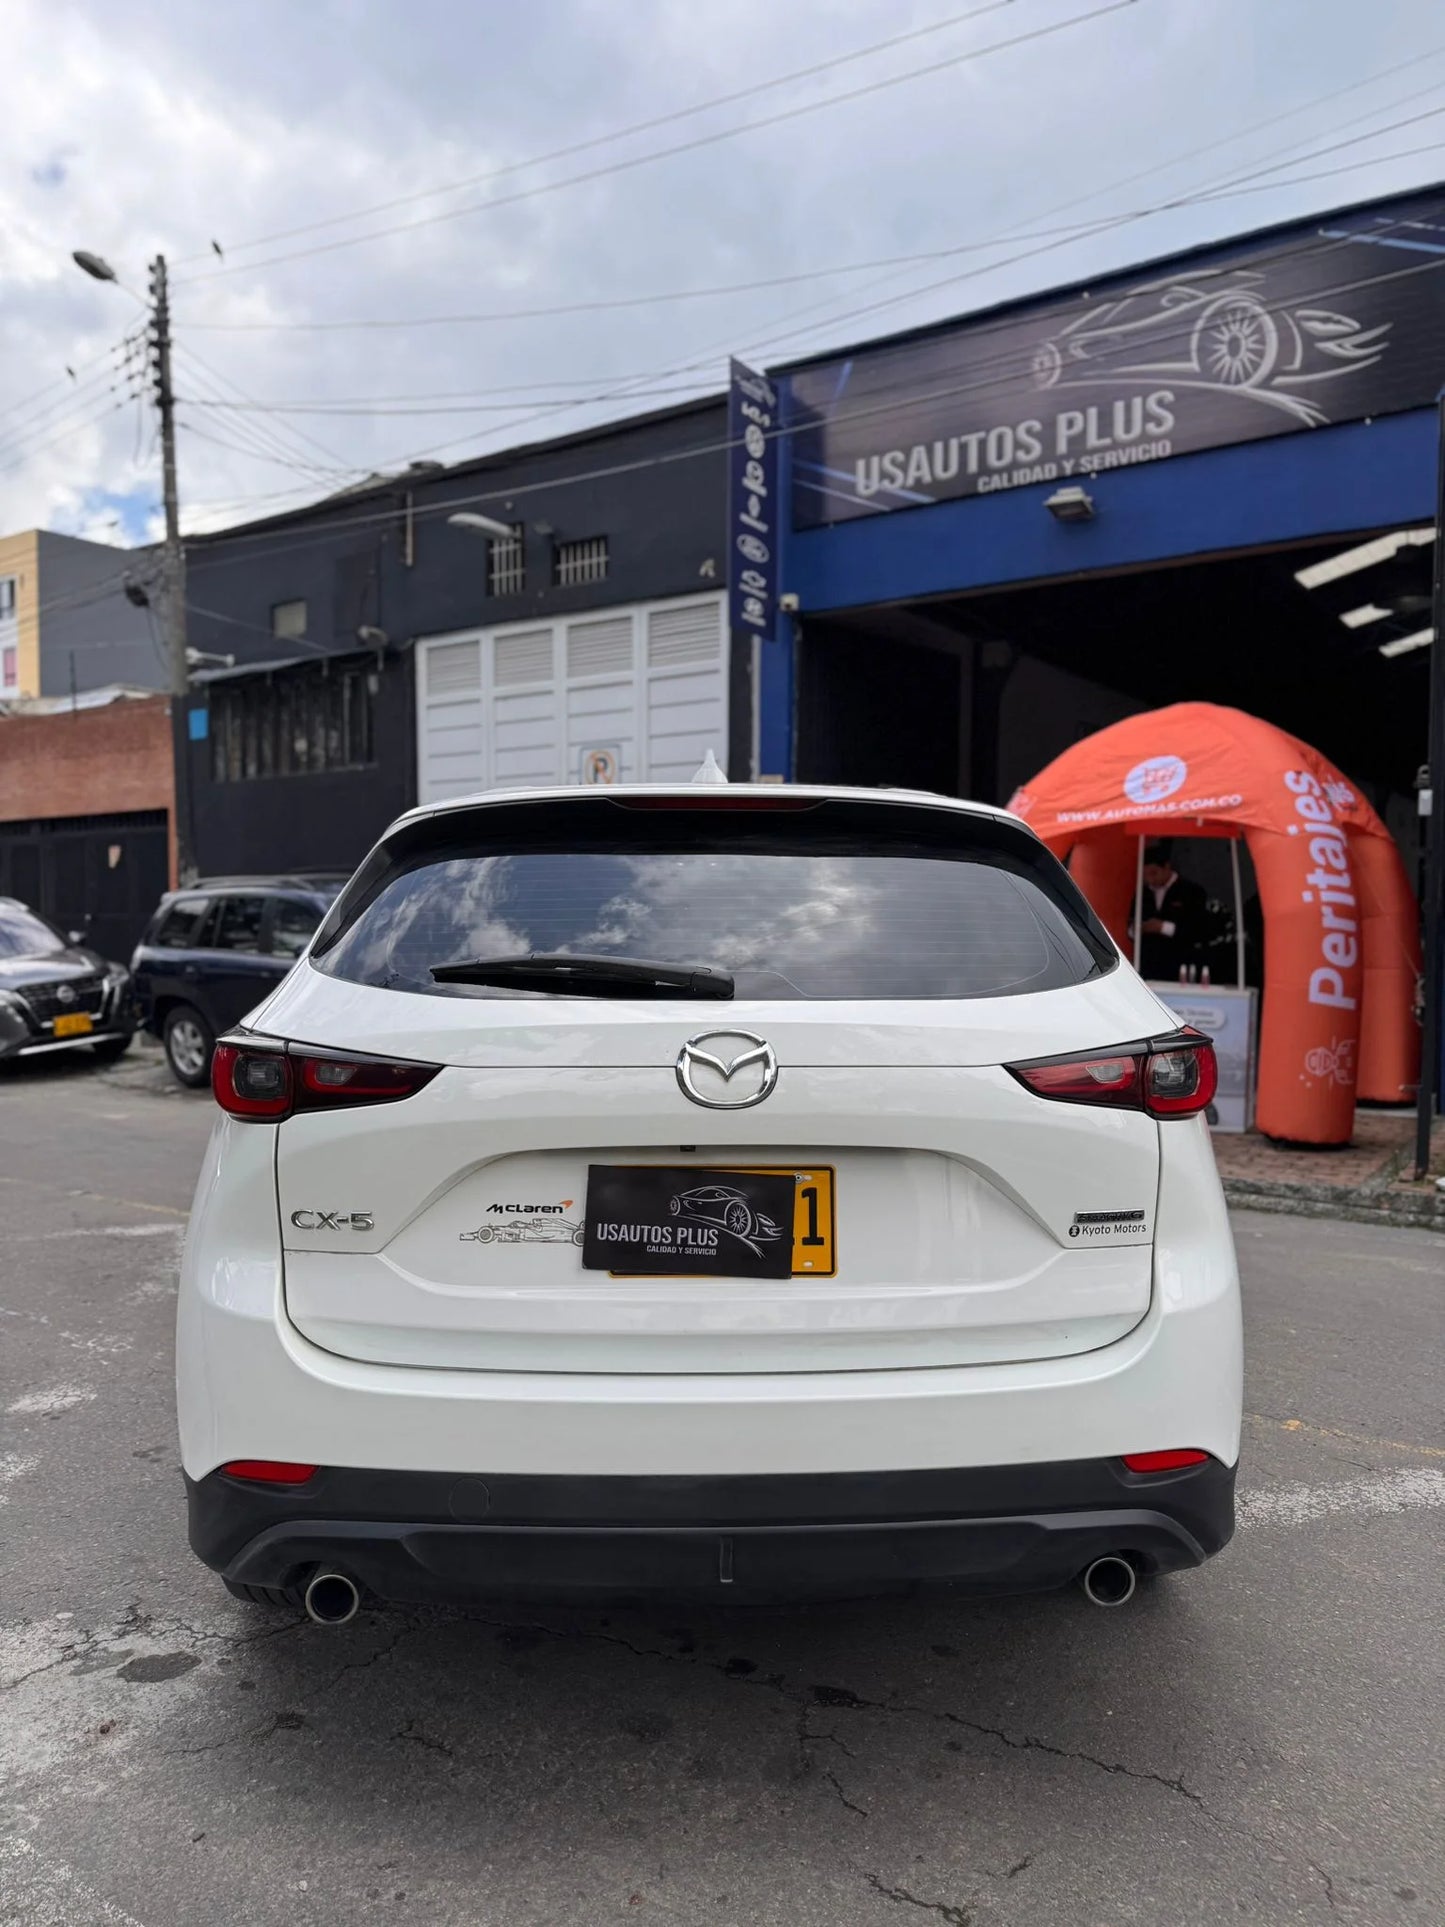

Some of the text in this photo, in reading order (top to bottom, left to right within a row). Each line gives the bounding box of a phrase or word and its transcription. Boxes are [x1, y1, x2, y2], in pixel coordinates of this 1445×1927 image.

[855, 390, 1176, 497] USAUTOS PLUS
[977, 440, 1172, 493] CALIDAD Y SERVICIO
[1284, 770, 1357, 1011] Peritajes
[291, 1209, 375, 1231] CX-5
[486, 1204, 563, 1214] McLaren
[801, 1187, 825, 1246] 1
[597, 1223, 719, 1246] USAUTOS PLUS
[1081, 1224, 1147, 1237] Kyoto Motors
[646, 1245, 717, 1256] CALIDAD Y SERVICIO
